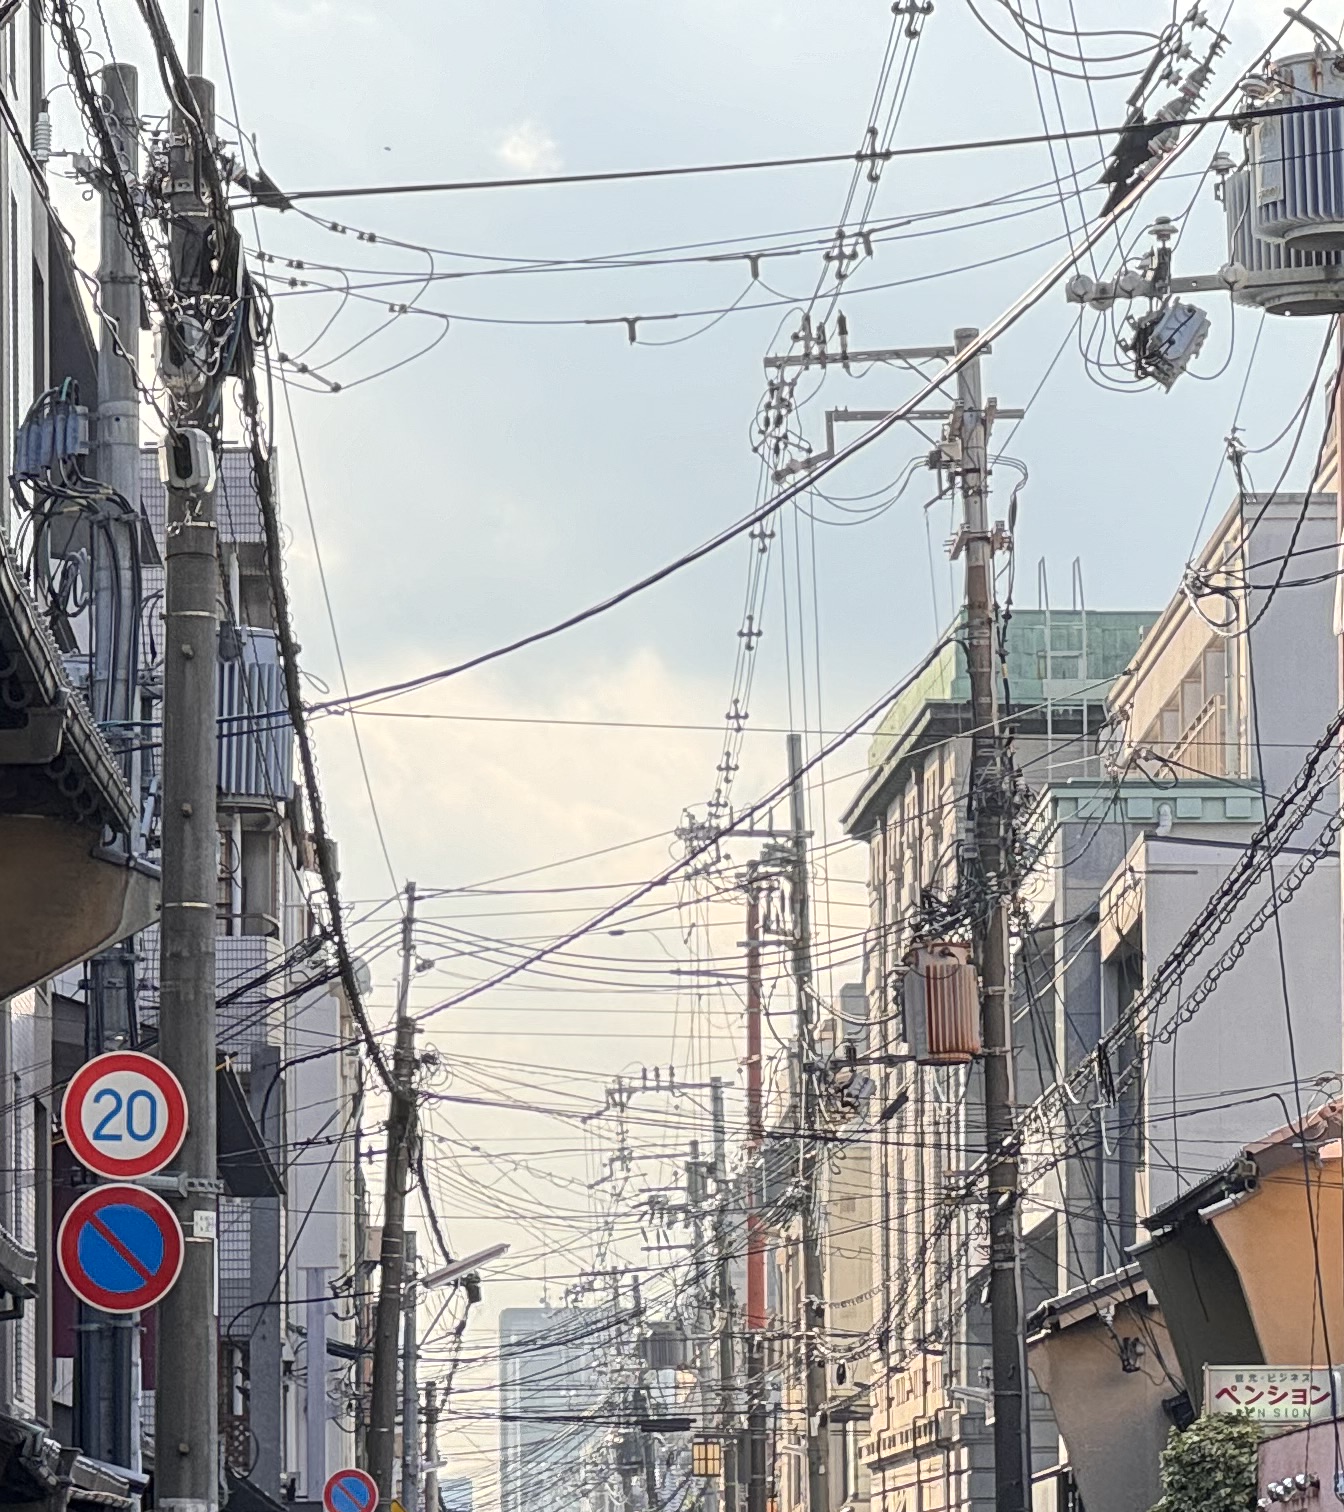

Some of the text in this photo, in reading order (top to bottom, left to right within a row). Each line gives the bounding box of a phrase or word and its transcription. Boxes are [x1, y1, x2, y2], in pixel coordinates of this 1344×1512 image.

[92, 1088, 158, 1142] 20
[1215, 1385, 1331, 1406] ペンション
